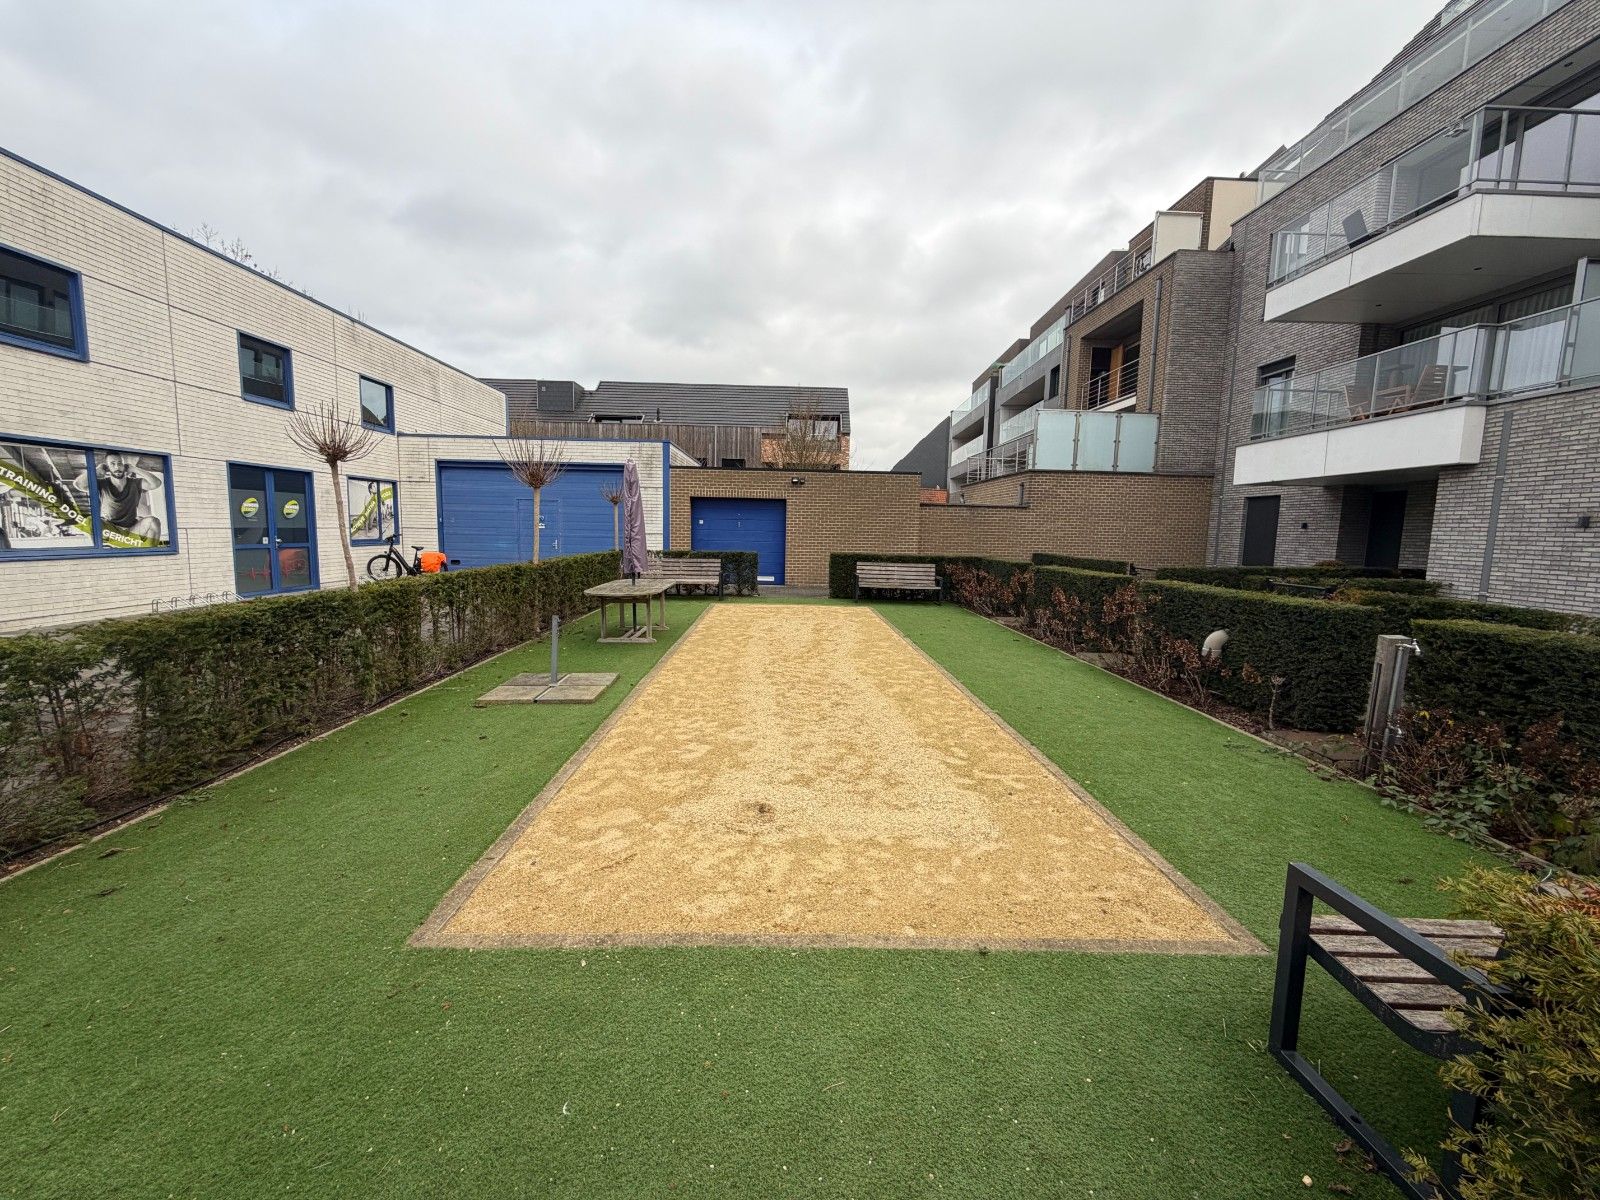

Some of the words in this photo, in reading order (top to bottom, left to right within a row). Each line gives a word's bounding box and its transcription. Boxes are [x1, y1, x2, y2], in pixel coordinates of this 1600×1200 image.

[0, 466, 57, 503] TRAINING
[60, 504, 87, 526] DOEL
[102, 529, 144, 547] GERICHT
